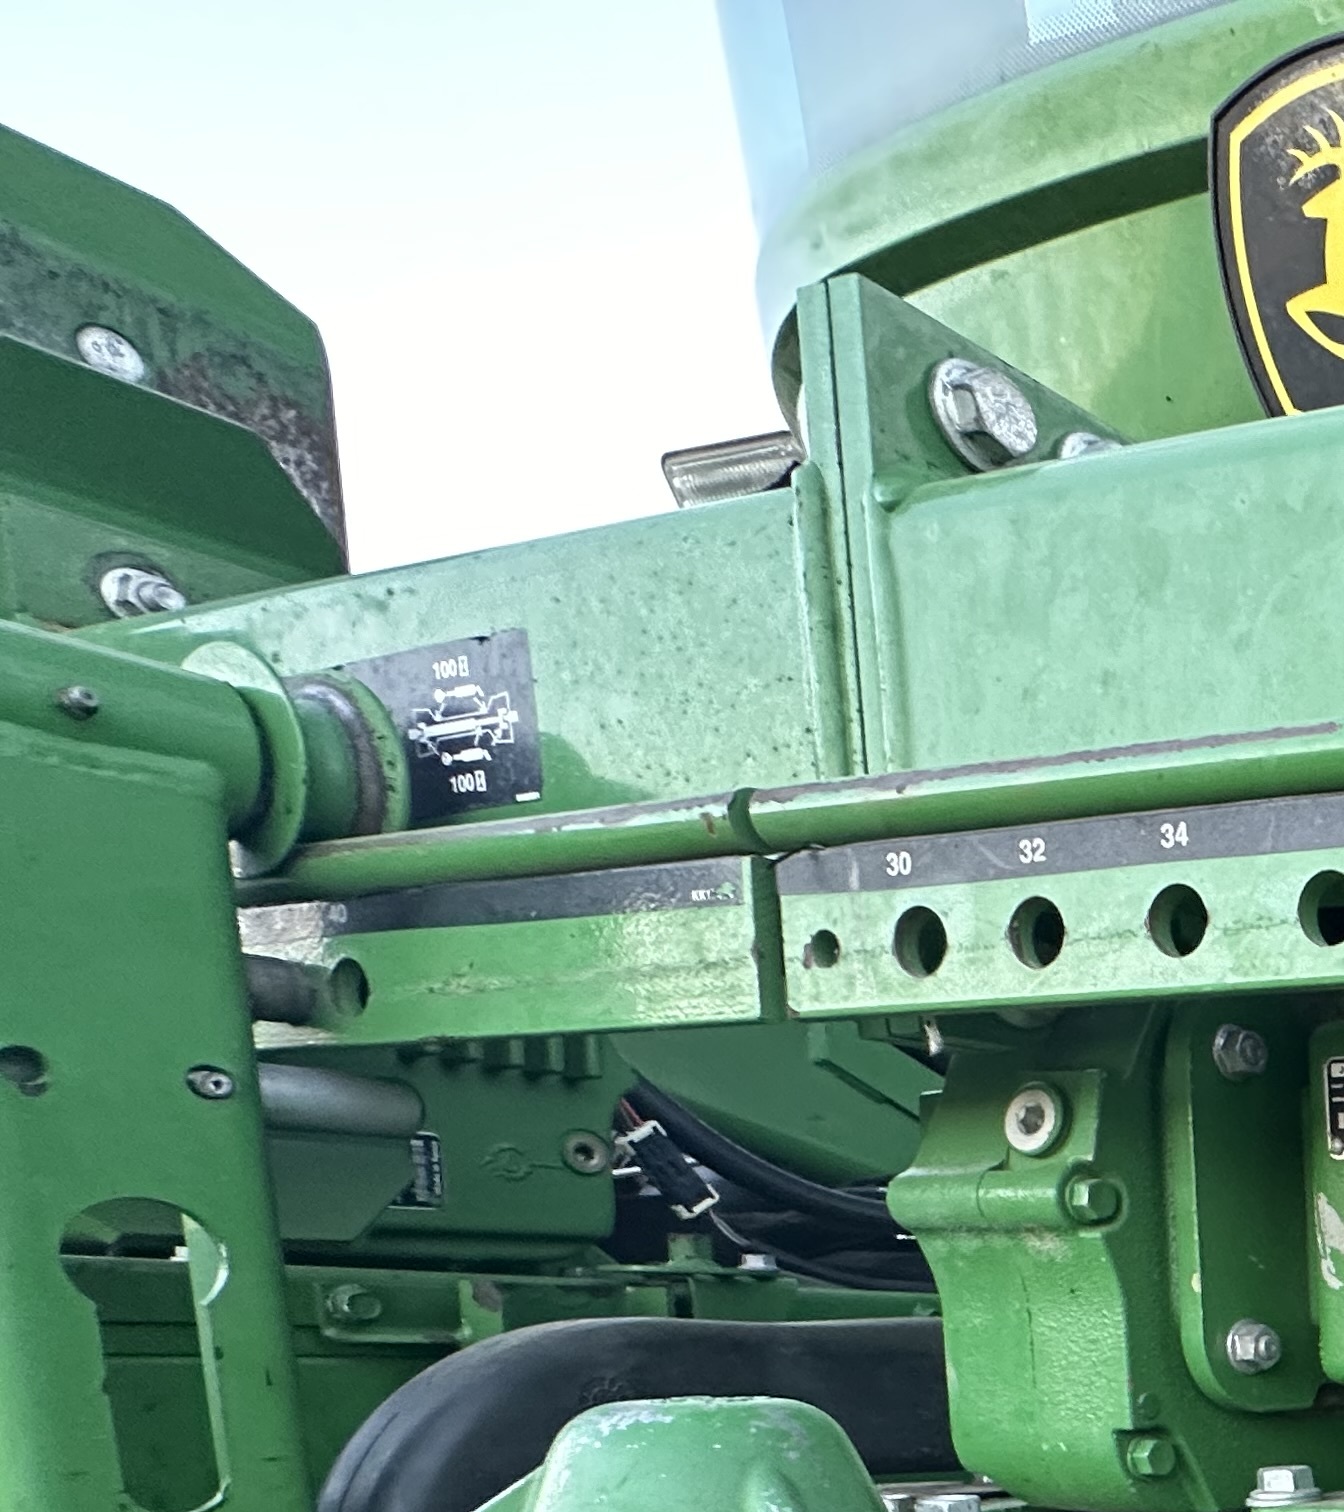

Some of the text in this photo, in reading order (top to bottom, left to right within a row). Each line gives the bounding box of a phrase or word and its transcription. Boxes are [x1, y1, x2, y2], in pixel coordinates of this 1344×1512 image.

[885, 821, 1189, 877] 30 32 34
